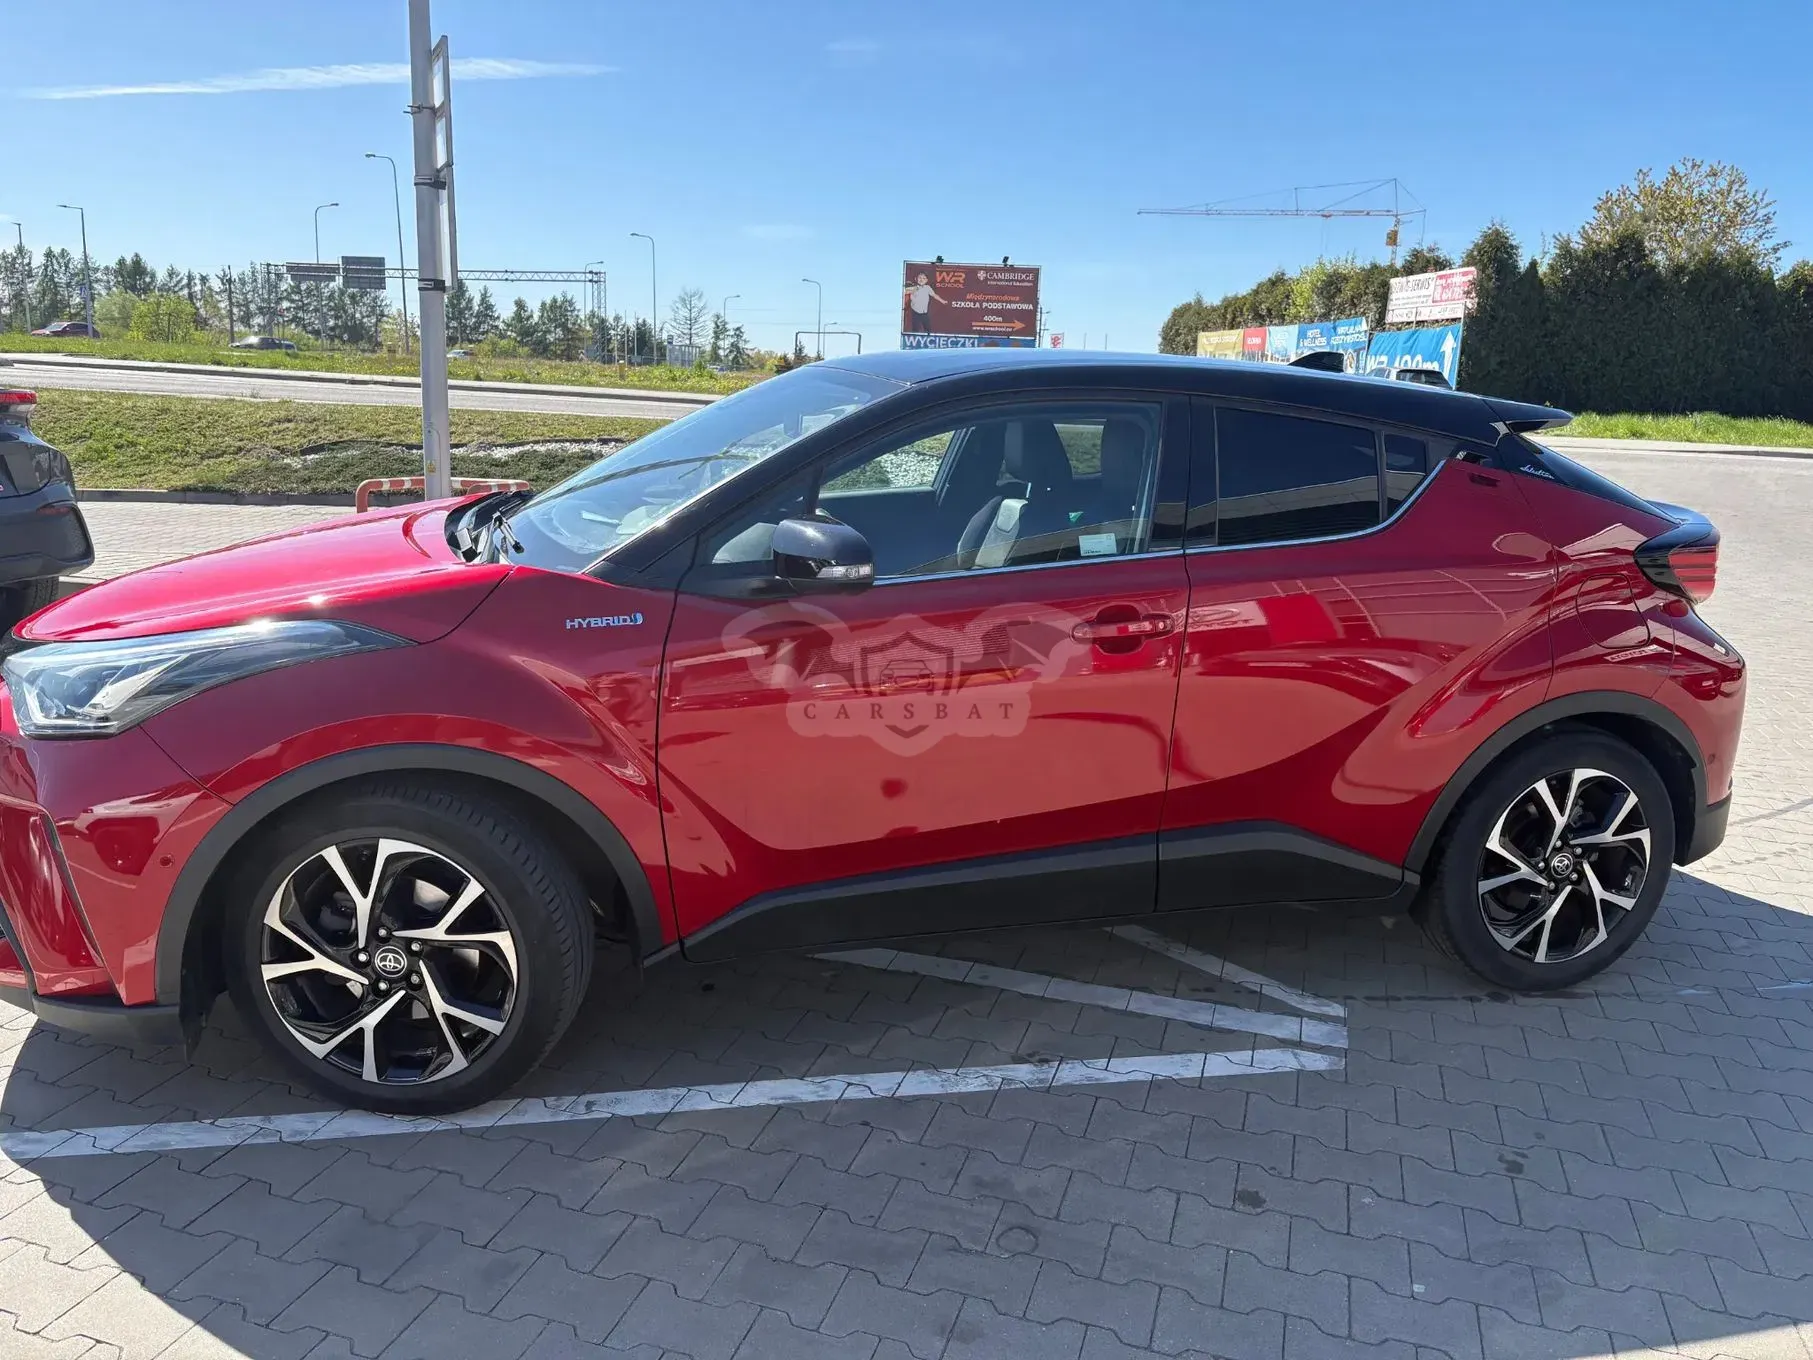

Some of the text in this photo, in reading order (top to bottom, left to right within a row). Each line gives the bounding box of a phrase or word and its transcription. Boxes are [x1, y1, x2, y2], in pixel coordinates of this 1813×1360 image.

[936, 271, 966, 283] WR
[987, 272, 1035, 281] CAMBRIDGE
[951, 301, 1034, 311] SZKOŁA PODSTAWOWA
[905, 336, 978, 349] WYCIECZKI
[566, 615, 631, 629] HYBRID
